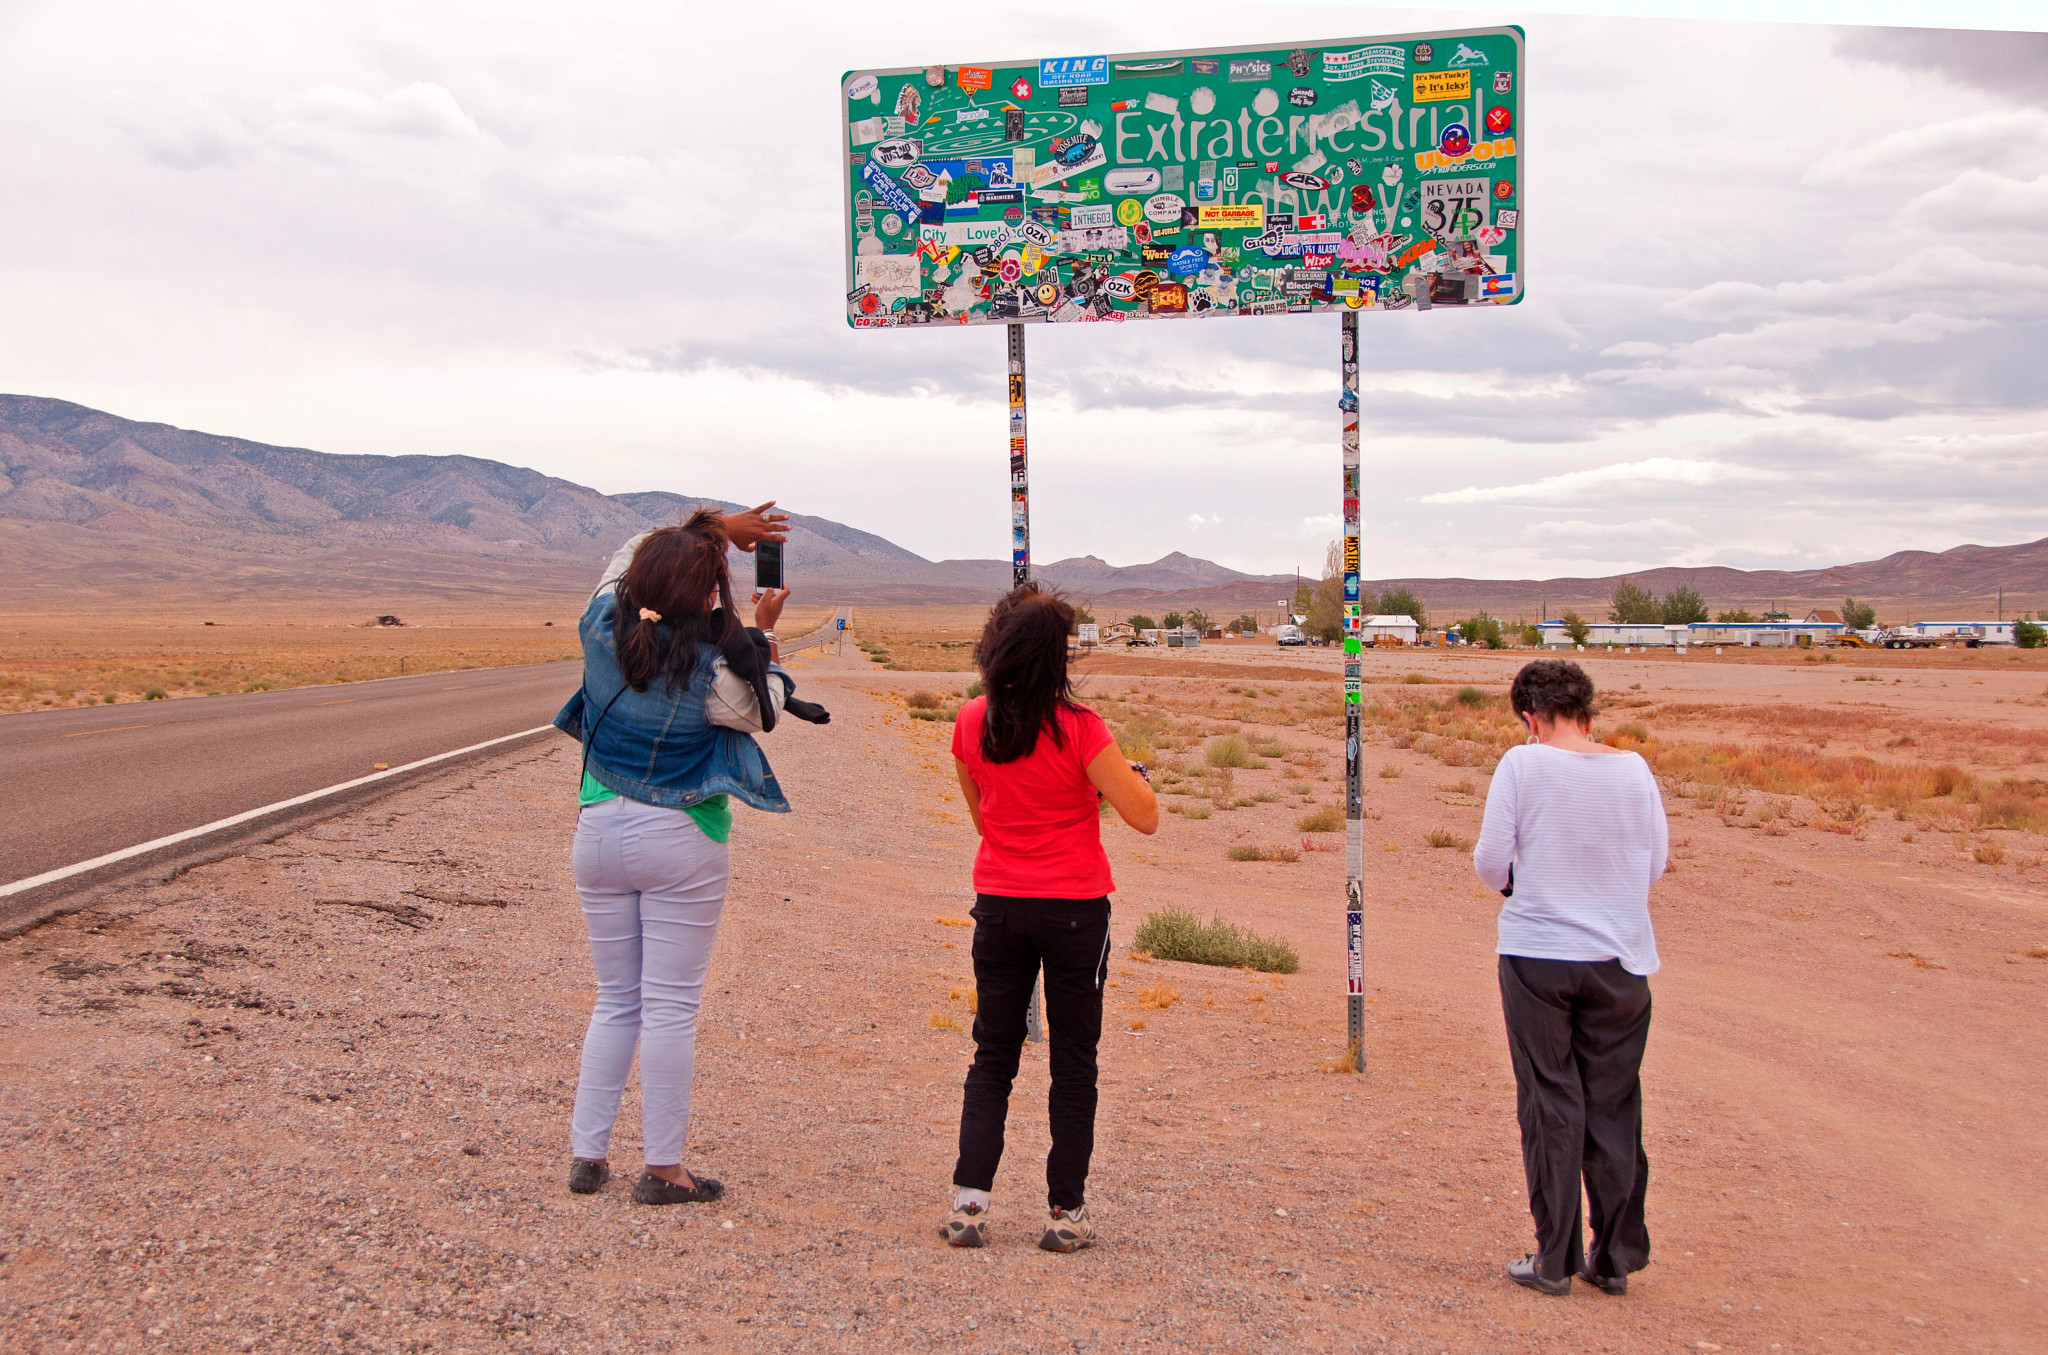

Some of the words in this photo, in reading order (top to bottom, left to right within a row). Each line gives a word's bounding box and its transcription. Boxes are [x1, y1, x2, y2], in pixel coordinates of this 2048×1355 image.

[1362, 48, 1393, 57] MEMORY
[1396, 50, 1405, 58] OF
[1043, 58, 1106, 73] KING
[1342, 61, 1365, 69] HOWIE
[1366, 57, 1404, 67] STEVENSON
[1444, 71, 1469, 79] Yucky!
[855, 81, 872, 93] kayak
[1429, 83, 1444, 91] It's
[1446, 81, 1469, 91] Icky!
[1056, 134, 1090, 154] YOSEMITE
[868, 160, 897, 190] SAVAGE
[1227, 174, 1235, 186] 0
[872, 174, 889, 192] CAR
[1427, 182, 1484, 197] NEVADA
[888, 190, 910, 213] CLUB
[896, 187, 922, 216] EMPIRE
[1150, 196, 1180, 205] RUMBLE
[1189, 175, 1405, 235] Hhwy
[1073, 212, 1111, 226] INTHE603
[1205, 210, 1220, 218] NOT
[1427, 197, 1484, 234] 375
[922, 228, 947, 243] City
[1142, 249, 1172, 261] Werk
[1281, 246, 1299, 256] LOCAL
[1304, 245, 1316, 254] 751
[1398, 237, 1437, 268] KTM
[1173, 259, 1190, 267] HASSLE
[1180, 263, 1198, 271] SPORTS
[1347, 537, 1359, 573] MYSTERY
[1353, 924, 1362, 936] MY
[1352, 937, 1362, 953] GUN
[1353, 954, 1362, 978] STORE
